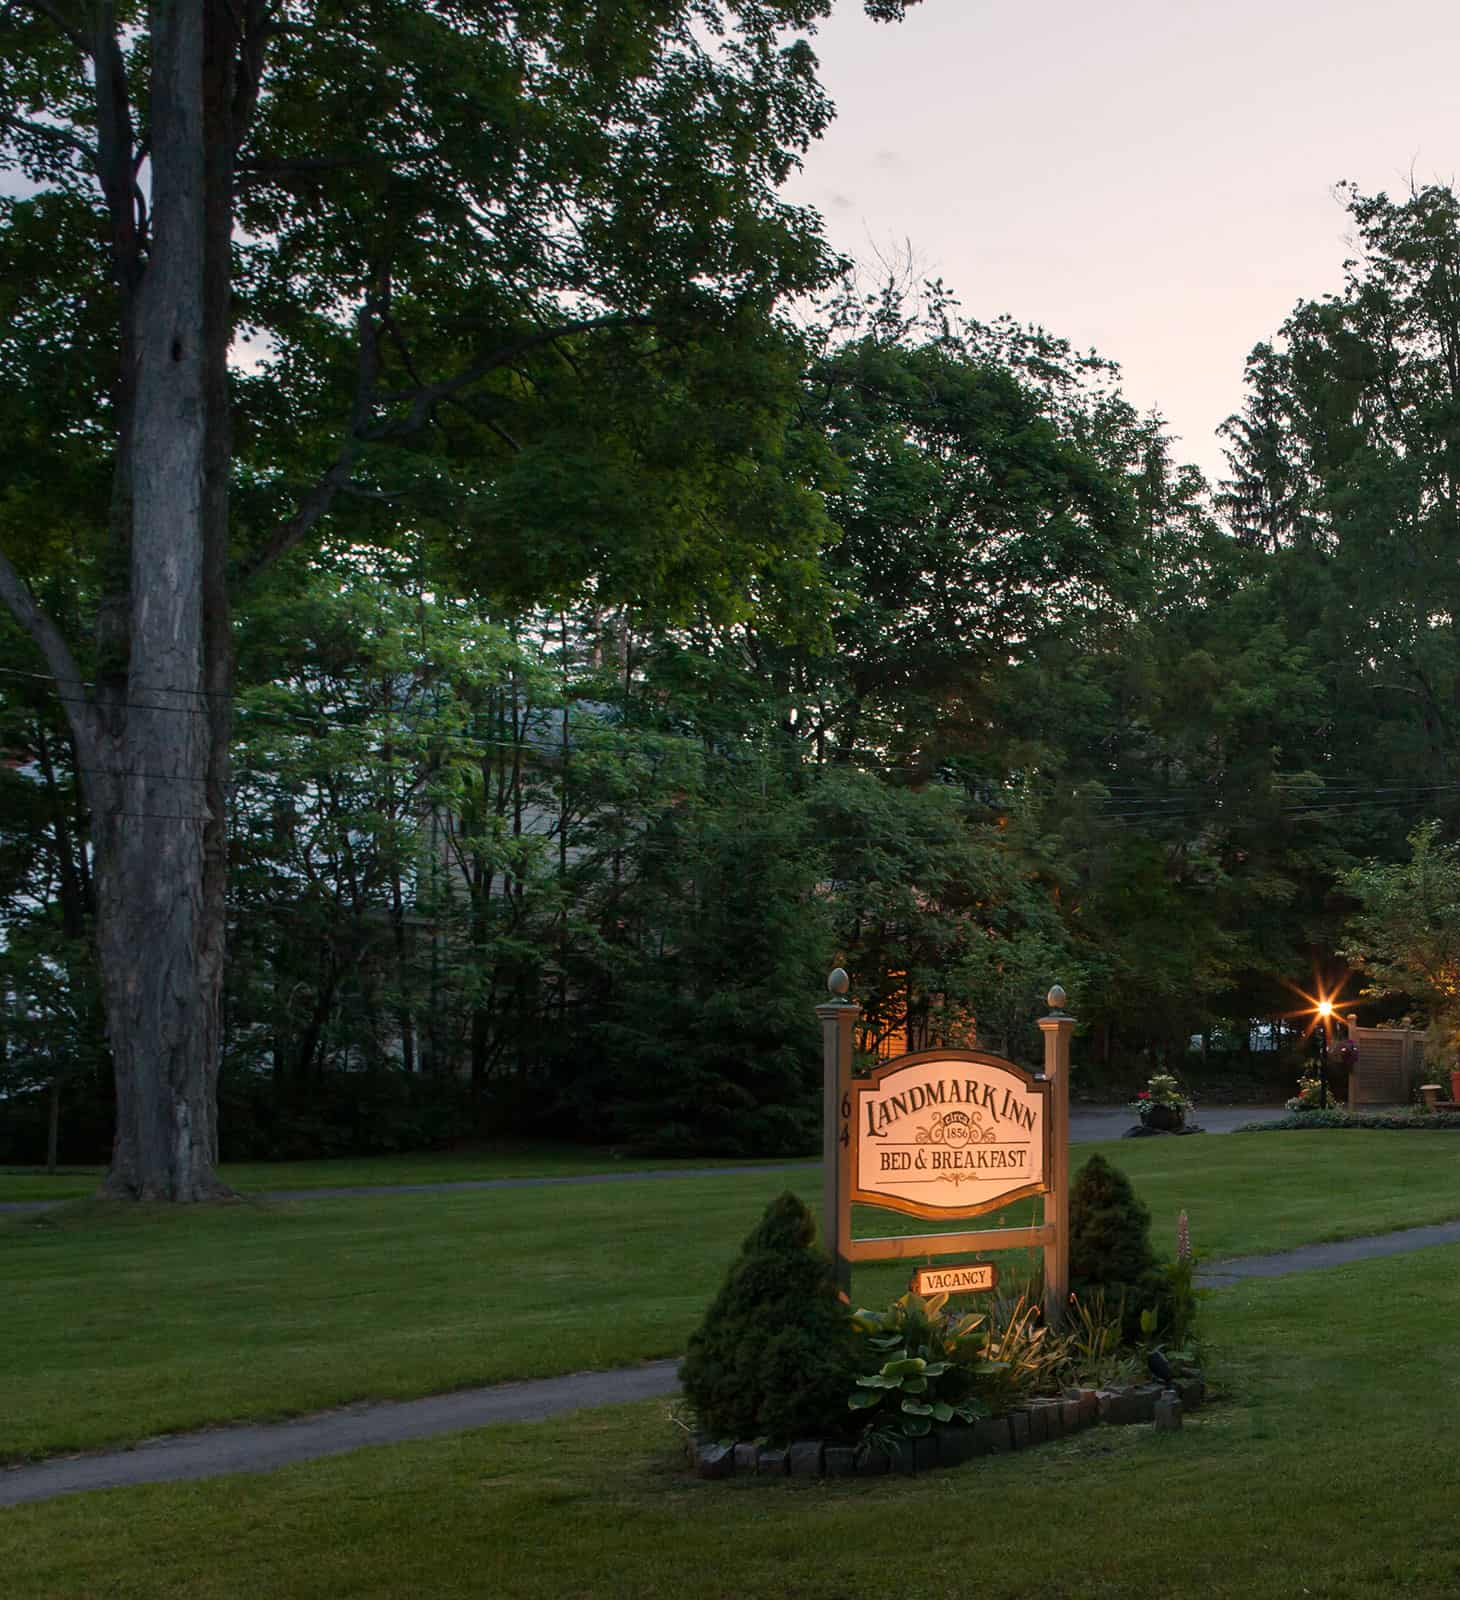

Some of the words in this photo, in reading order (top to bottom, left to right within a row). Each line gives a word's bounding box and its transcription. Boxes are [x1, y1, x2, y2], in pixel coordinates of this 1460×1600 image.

[866, 1079, 1000, 1138] LANDMARK
[1001, 1088, 1037, 1131] INN
[946, 1127, 968, 1138] 1856
[880, 1151, 911, 1171] BED
[915, 1149, 928, 1170] &
[932, 1150, 1027, 1170] BREAKFAST
[927, 1271, 986, 1288] VACANCY
